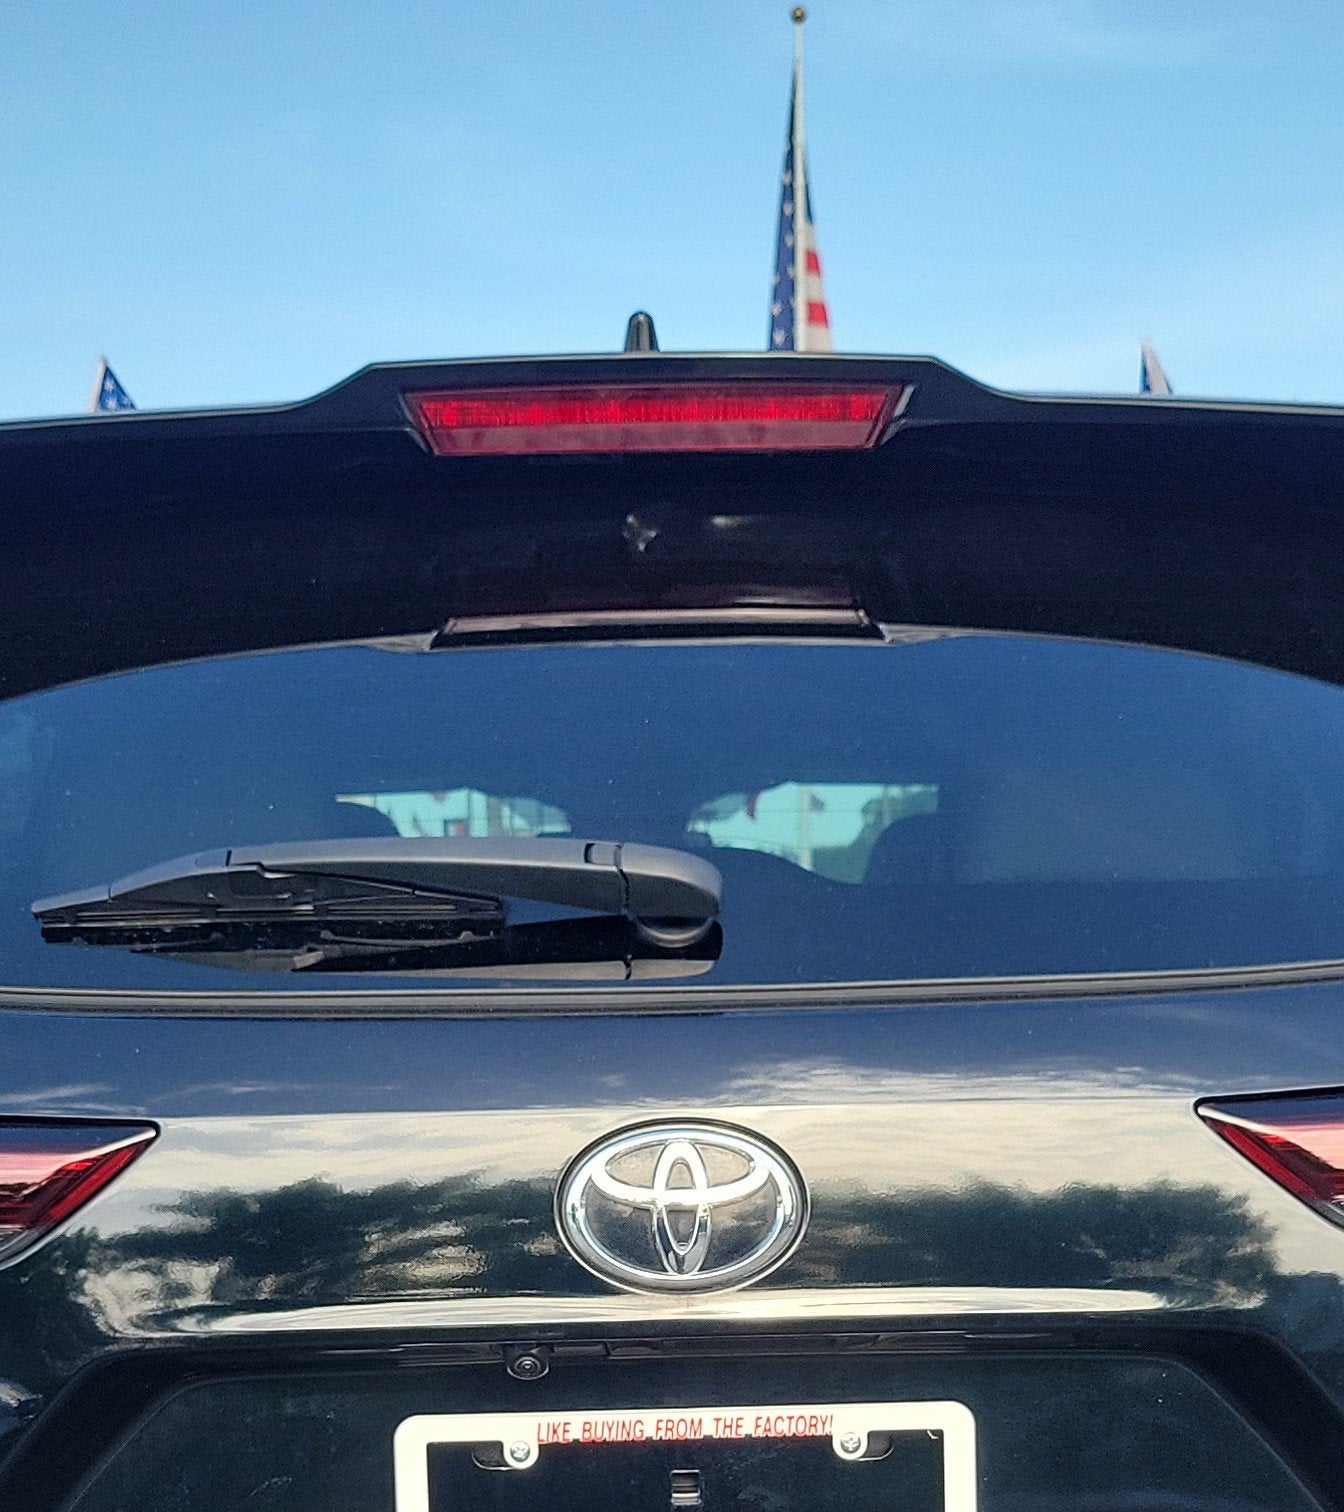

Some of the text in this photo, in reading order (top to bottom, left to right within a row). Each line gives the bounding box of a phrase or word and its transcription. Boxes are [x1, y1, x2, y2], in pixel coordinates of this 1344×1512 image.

[537, 1414, 834, 1444] LIKE BUYING FROM THE FACTORY!
